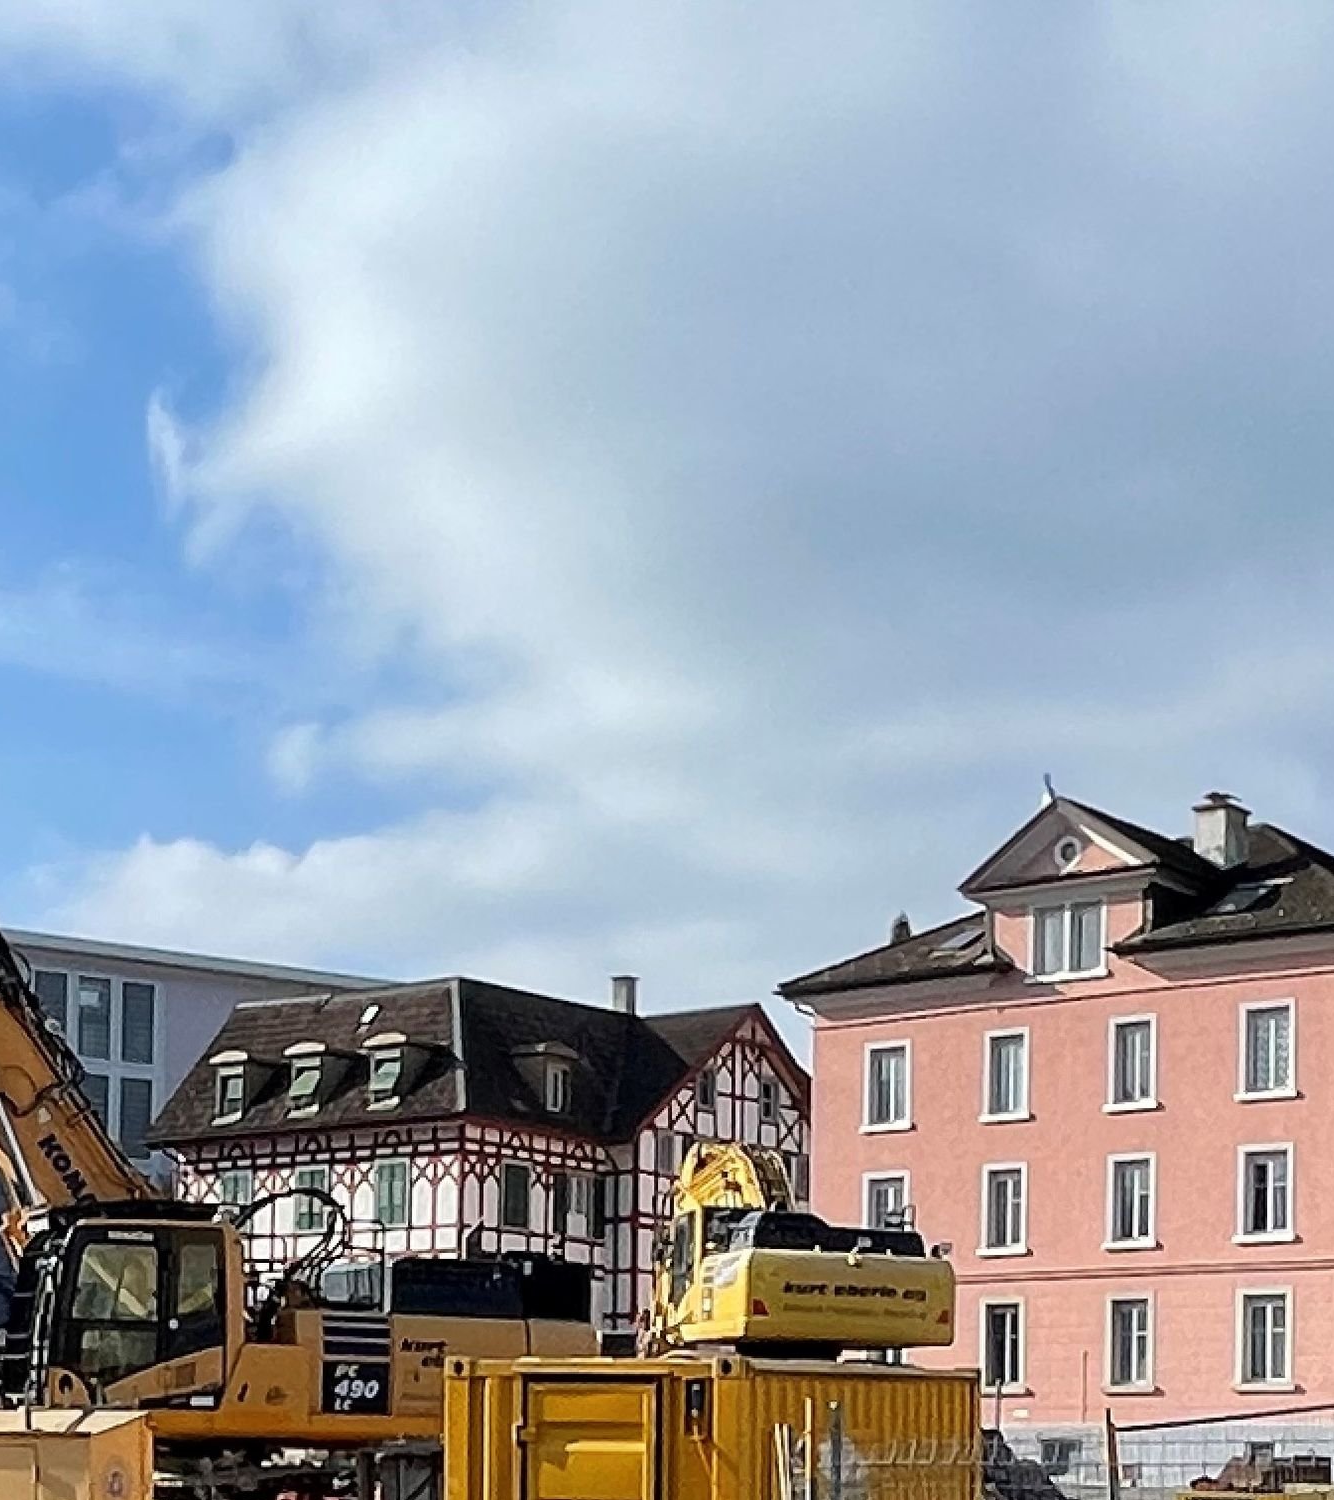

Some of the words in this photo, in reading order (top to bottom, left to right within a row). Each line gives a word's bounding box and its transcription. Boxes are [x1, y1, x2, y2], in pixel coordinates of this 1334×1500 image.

[783, 1280, 829, 1296] kurt
[334, 1363, 360, 1379] PC
[334, 1379, 380, 1399] 490
